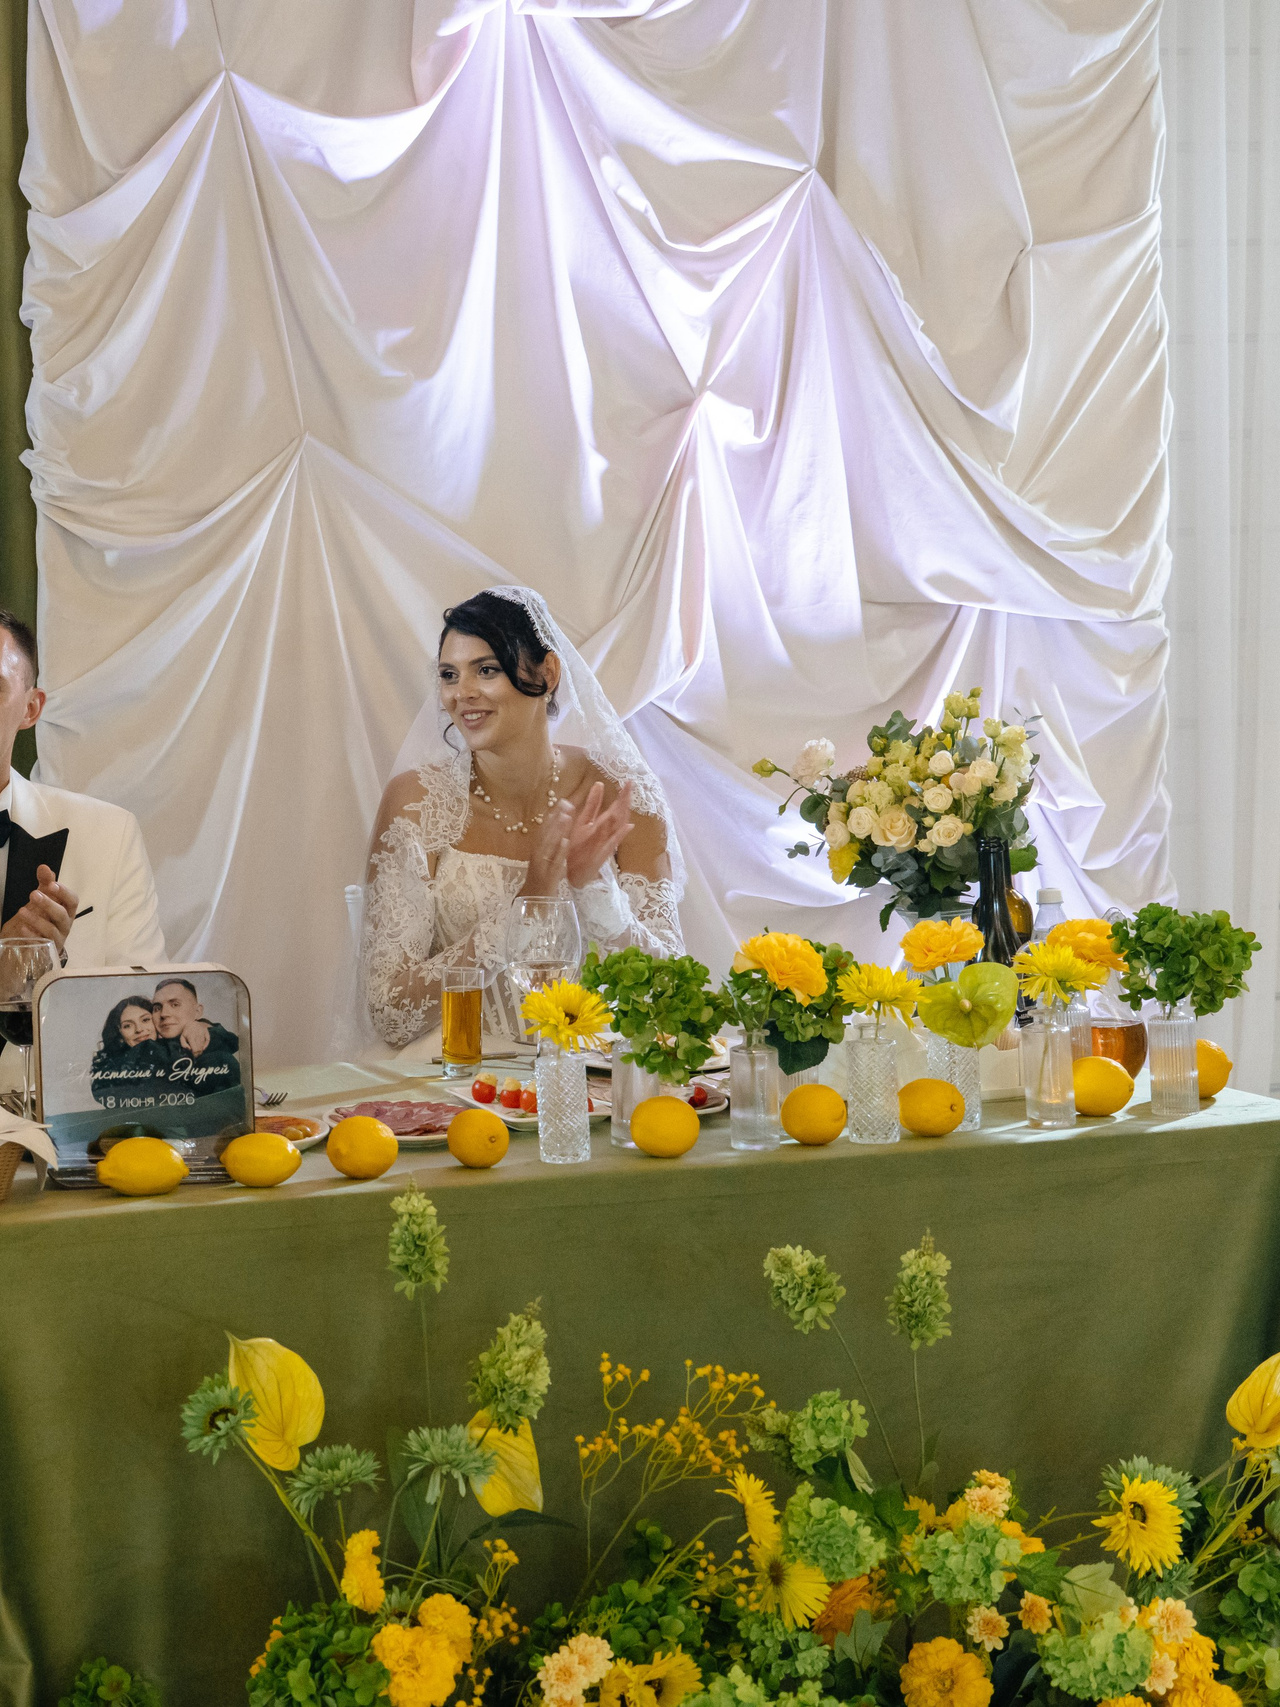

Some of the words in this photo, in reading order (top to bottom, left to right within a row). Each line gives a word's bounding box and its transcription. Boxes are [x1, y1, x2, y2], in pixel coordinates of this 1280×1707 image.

[155, 1068, 166, 1079] и
[168, 1057, 230, 1085] Андрей
[98, 1095, 116, 1109] 18
[119, 1096, 155, 1108] июня
[158, 1092, 196, 1107] 2026
